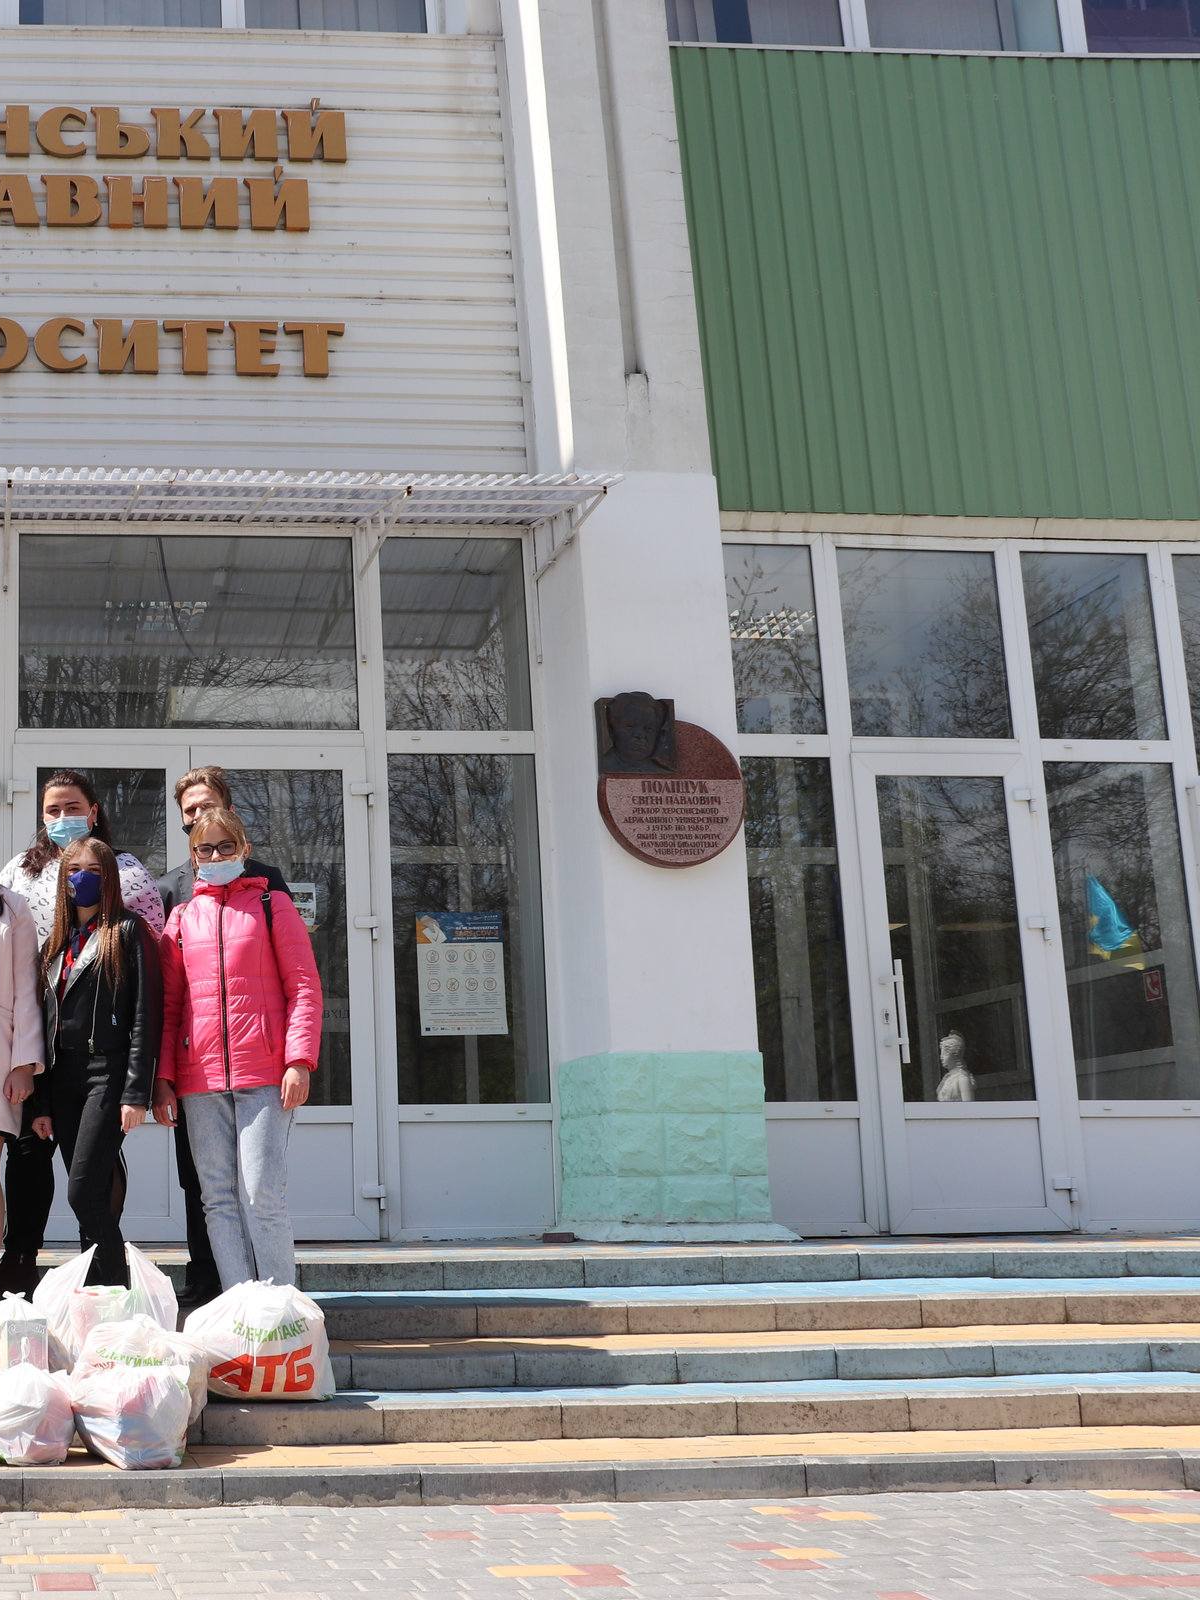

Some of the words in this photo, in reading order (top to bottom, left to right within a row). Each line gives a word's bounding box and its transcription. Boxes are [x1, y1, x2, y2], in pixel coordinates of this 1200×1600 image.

[641, 780, 709, 794] ПОЛІЩУК
[665, 796, 722, 805] ПАВЛОВИЧ
[210, 1344, 315, 1392] АТБ
